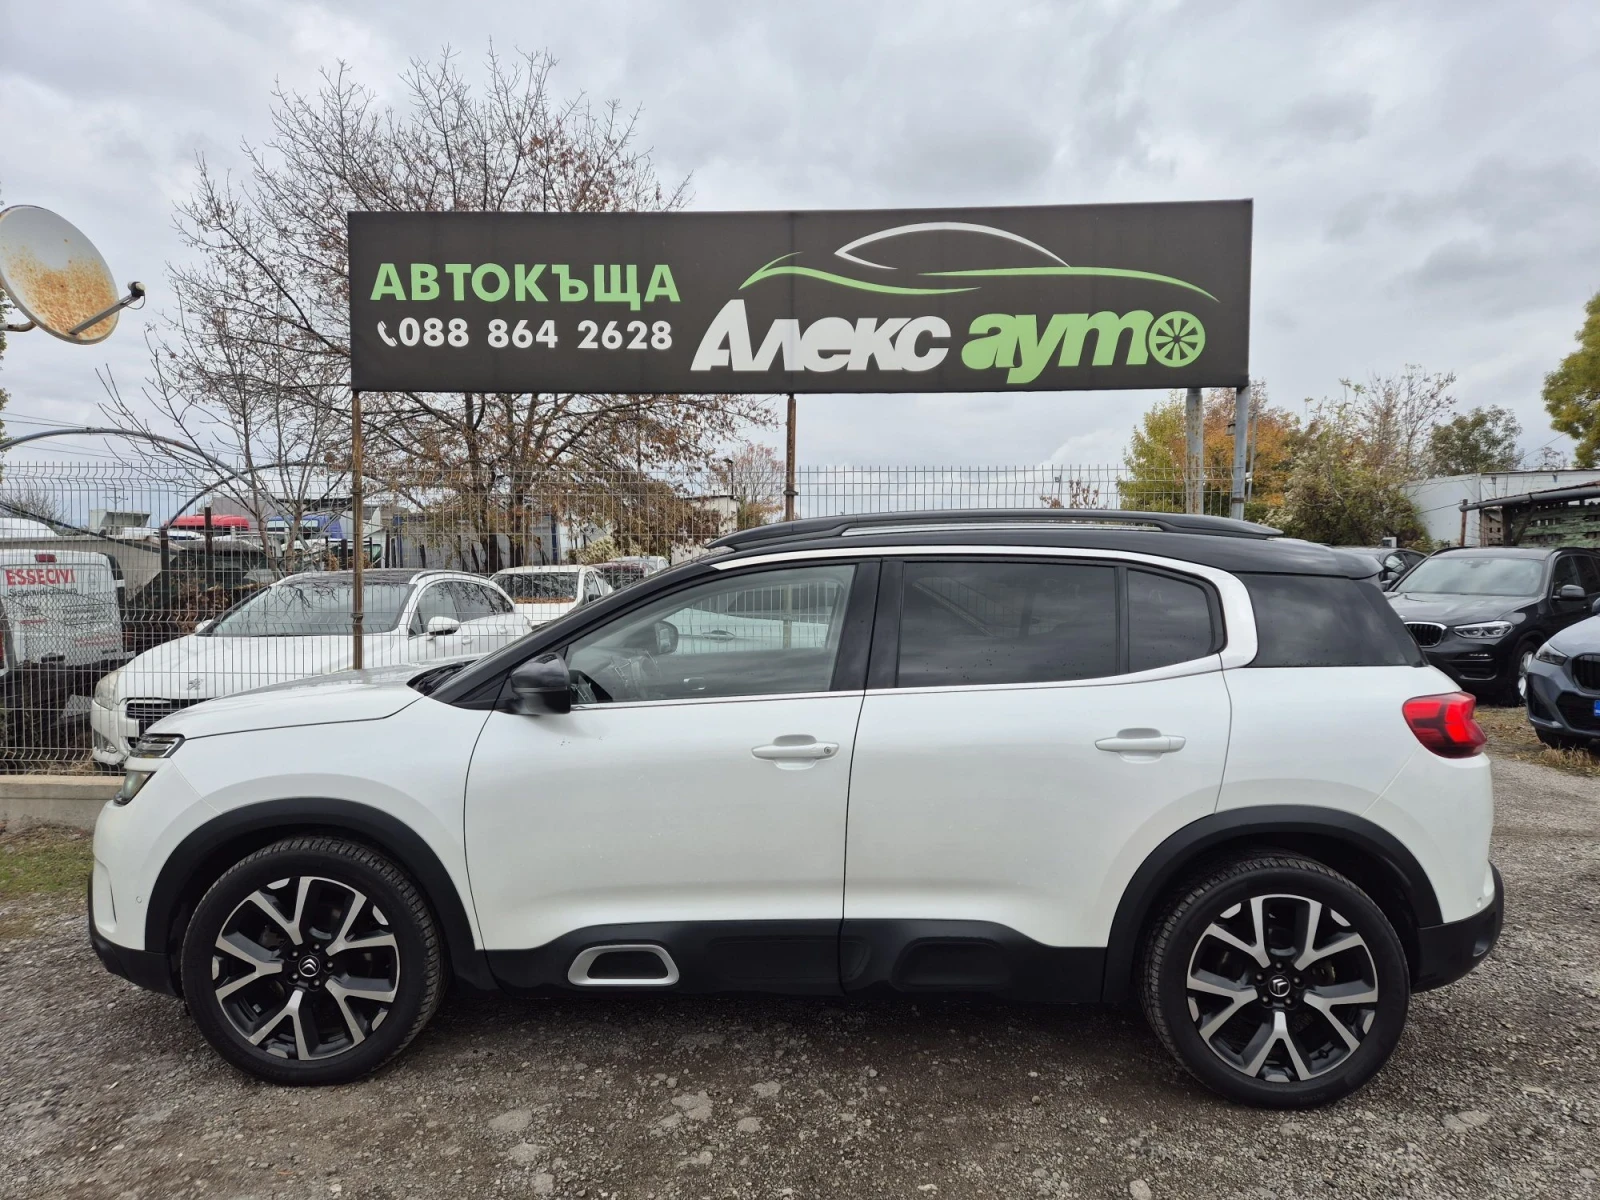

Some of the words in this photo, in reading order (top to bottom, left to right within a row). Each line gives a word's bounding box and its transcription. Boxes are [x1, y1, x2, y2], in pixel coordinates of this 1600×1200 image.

[369, 263, 681, 311] АВТОКЪЩА
[399, 317, 470, 348] 088
[487, 318, 559, 349] 864
[577, 320, 673, 350] 2628
[690, 299, 951, 372] Алекс
[5, 568, 76, 585] ESSECIVI
